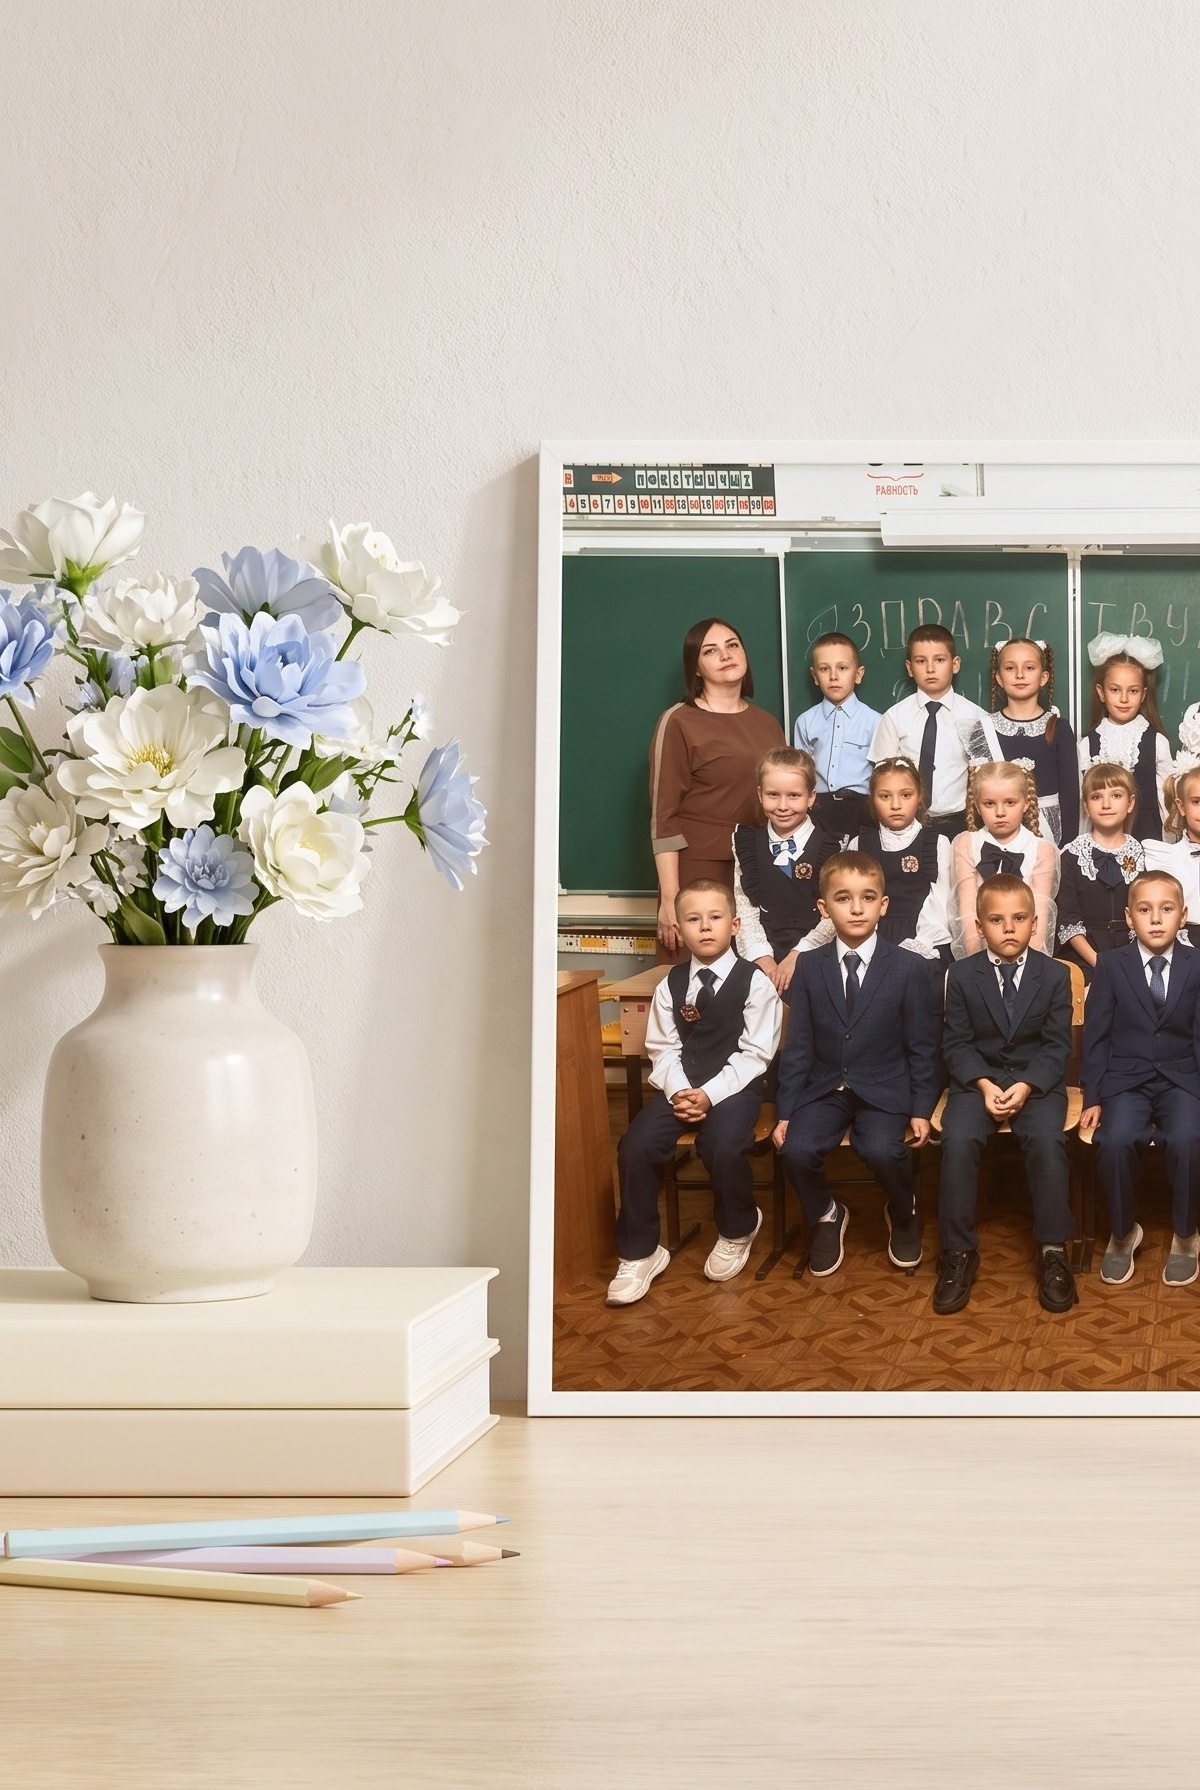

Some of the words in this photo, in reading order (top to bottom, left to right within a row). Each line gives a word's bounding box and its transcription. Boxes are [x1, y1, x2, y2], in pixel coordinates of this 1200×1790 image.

[580, 499, 587, 509] 5
[592, 499, 599, 509] 6
[604, 499, 611, 509] 7
